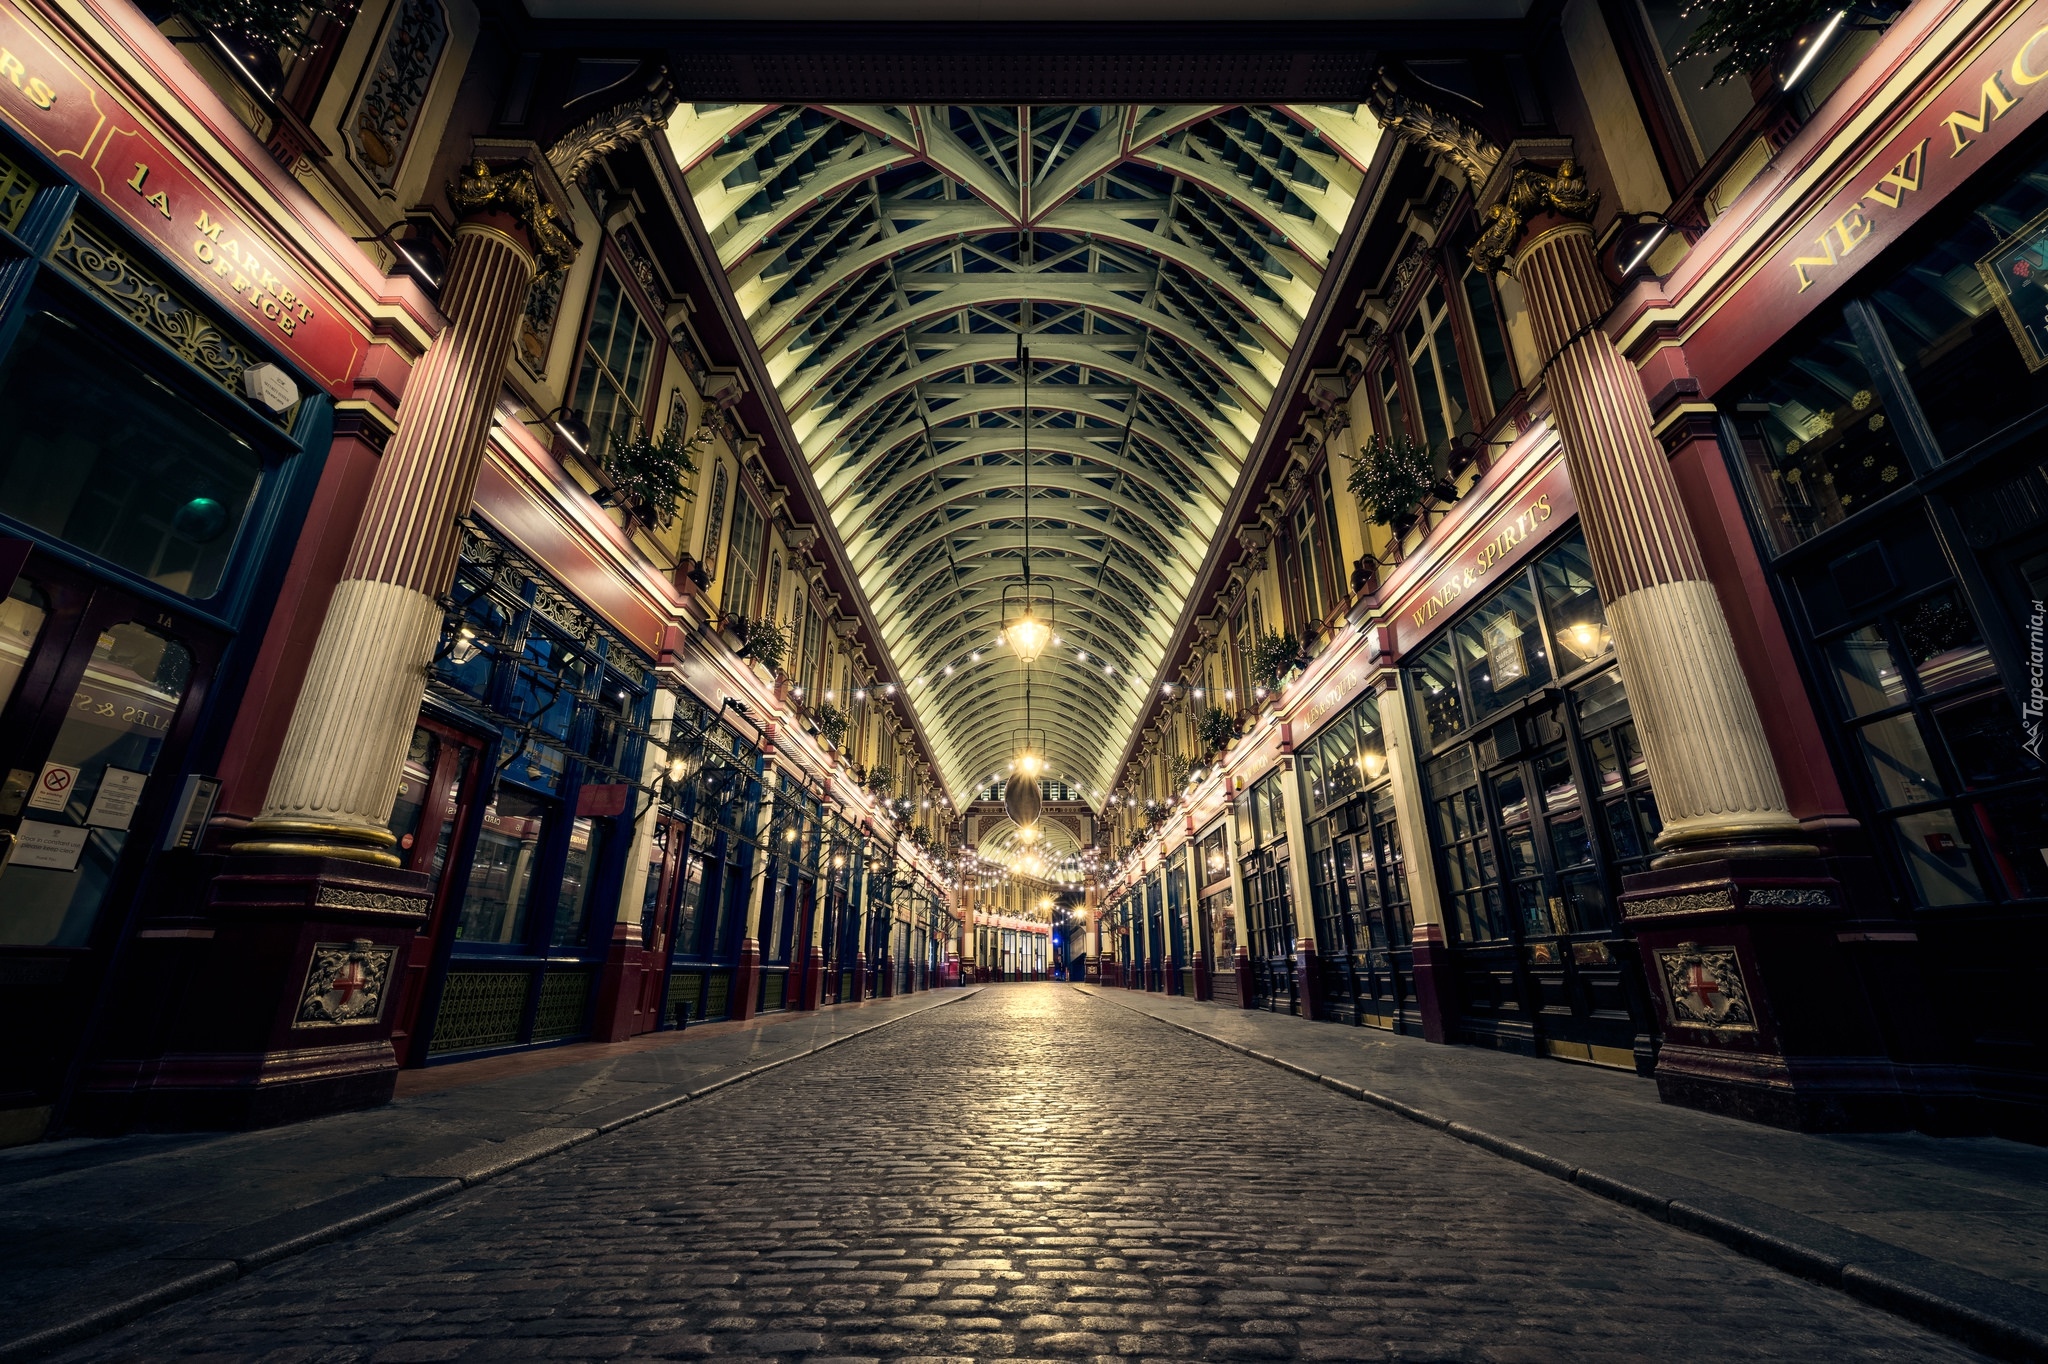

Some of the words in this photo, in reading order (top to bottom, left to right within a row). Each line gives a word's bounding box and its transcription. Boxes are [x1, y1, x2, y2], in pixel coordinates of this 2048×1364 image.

[127, 162, 171, 220] 1A
[1790, 138, 1931, 294] NEW
[194, 239, 297, 338] OFFICE
[195, 209, 314, 323] MARKET
[1412, 575, 1461, 628] WINES
[1463, 567, 1477, 590] &
[1477, 493, 1553, 576] SPIRITS
[156, 613, 174, 628] 1A
[1304, 710, 1321, 732] ALES
[1319, 700, 1327, 715] &
[1326, 668, 1358, 709] STOUTS
[20, 834, 36, 842] Door
[43, 838, 70, 846] constant
[20, 842, 42, 850] please
